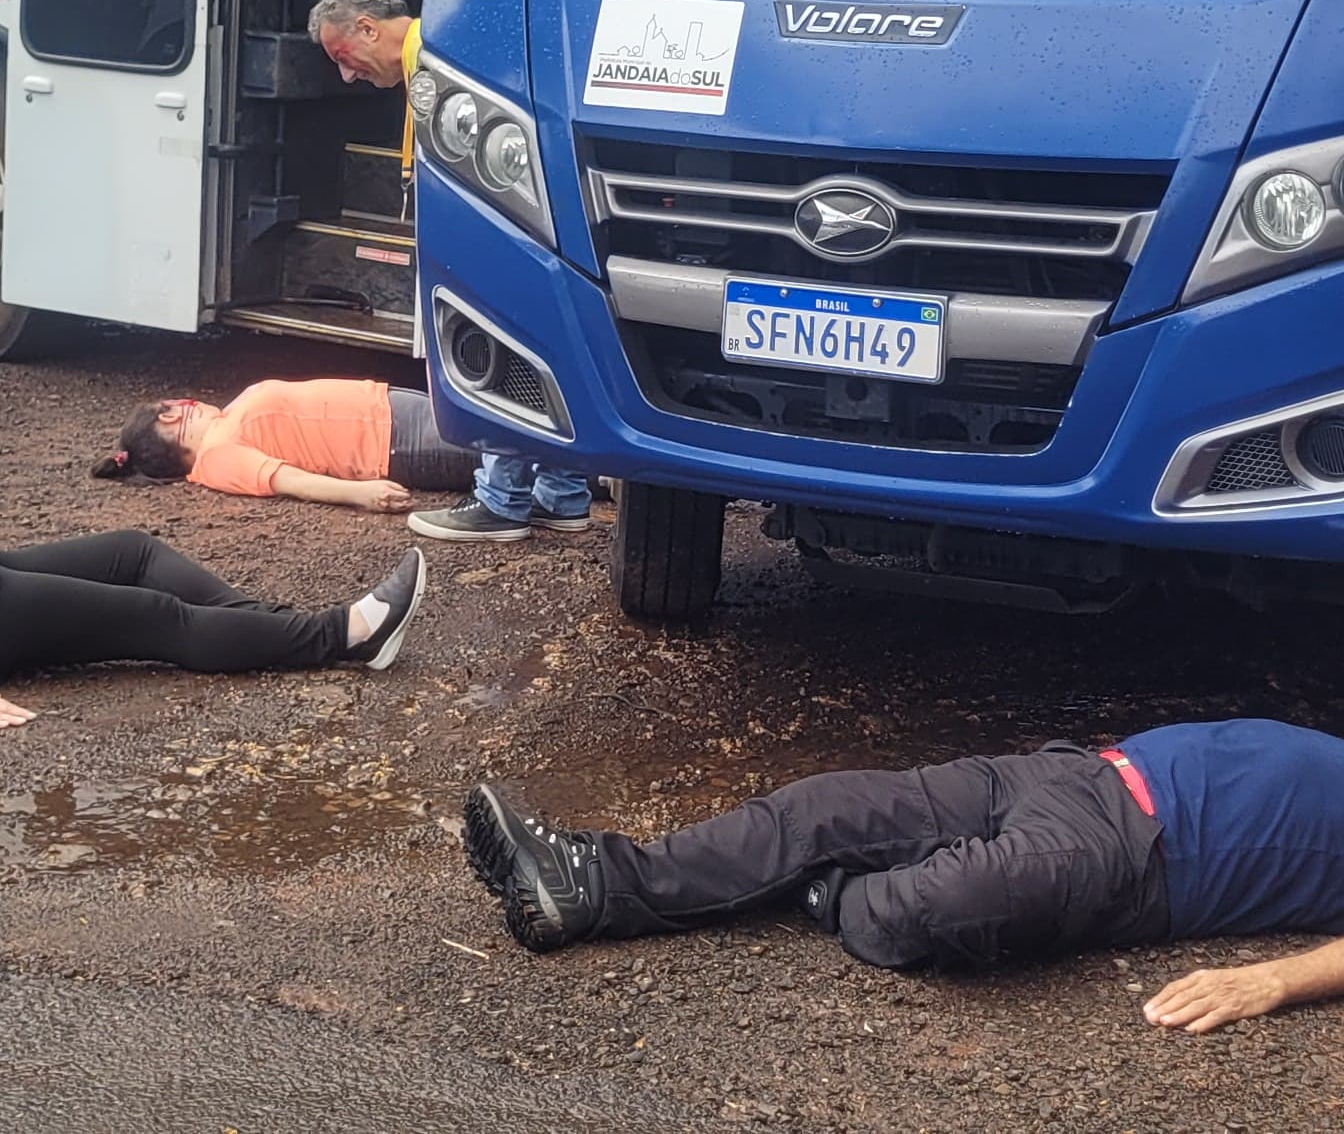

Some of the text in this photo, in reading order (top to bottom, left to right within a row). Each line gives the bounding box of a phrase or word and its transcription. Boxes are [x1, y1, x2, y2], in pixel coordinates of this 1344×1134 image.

[784, 4, 944, 37] Volare
[815, 298, 850, 312] BRASIL
[728, 337, 740, 352] BR
[745, 309, 916, 368] SFN6H49
